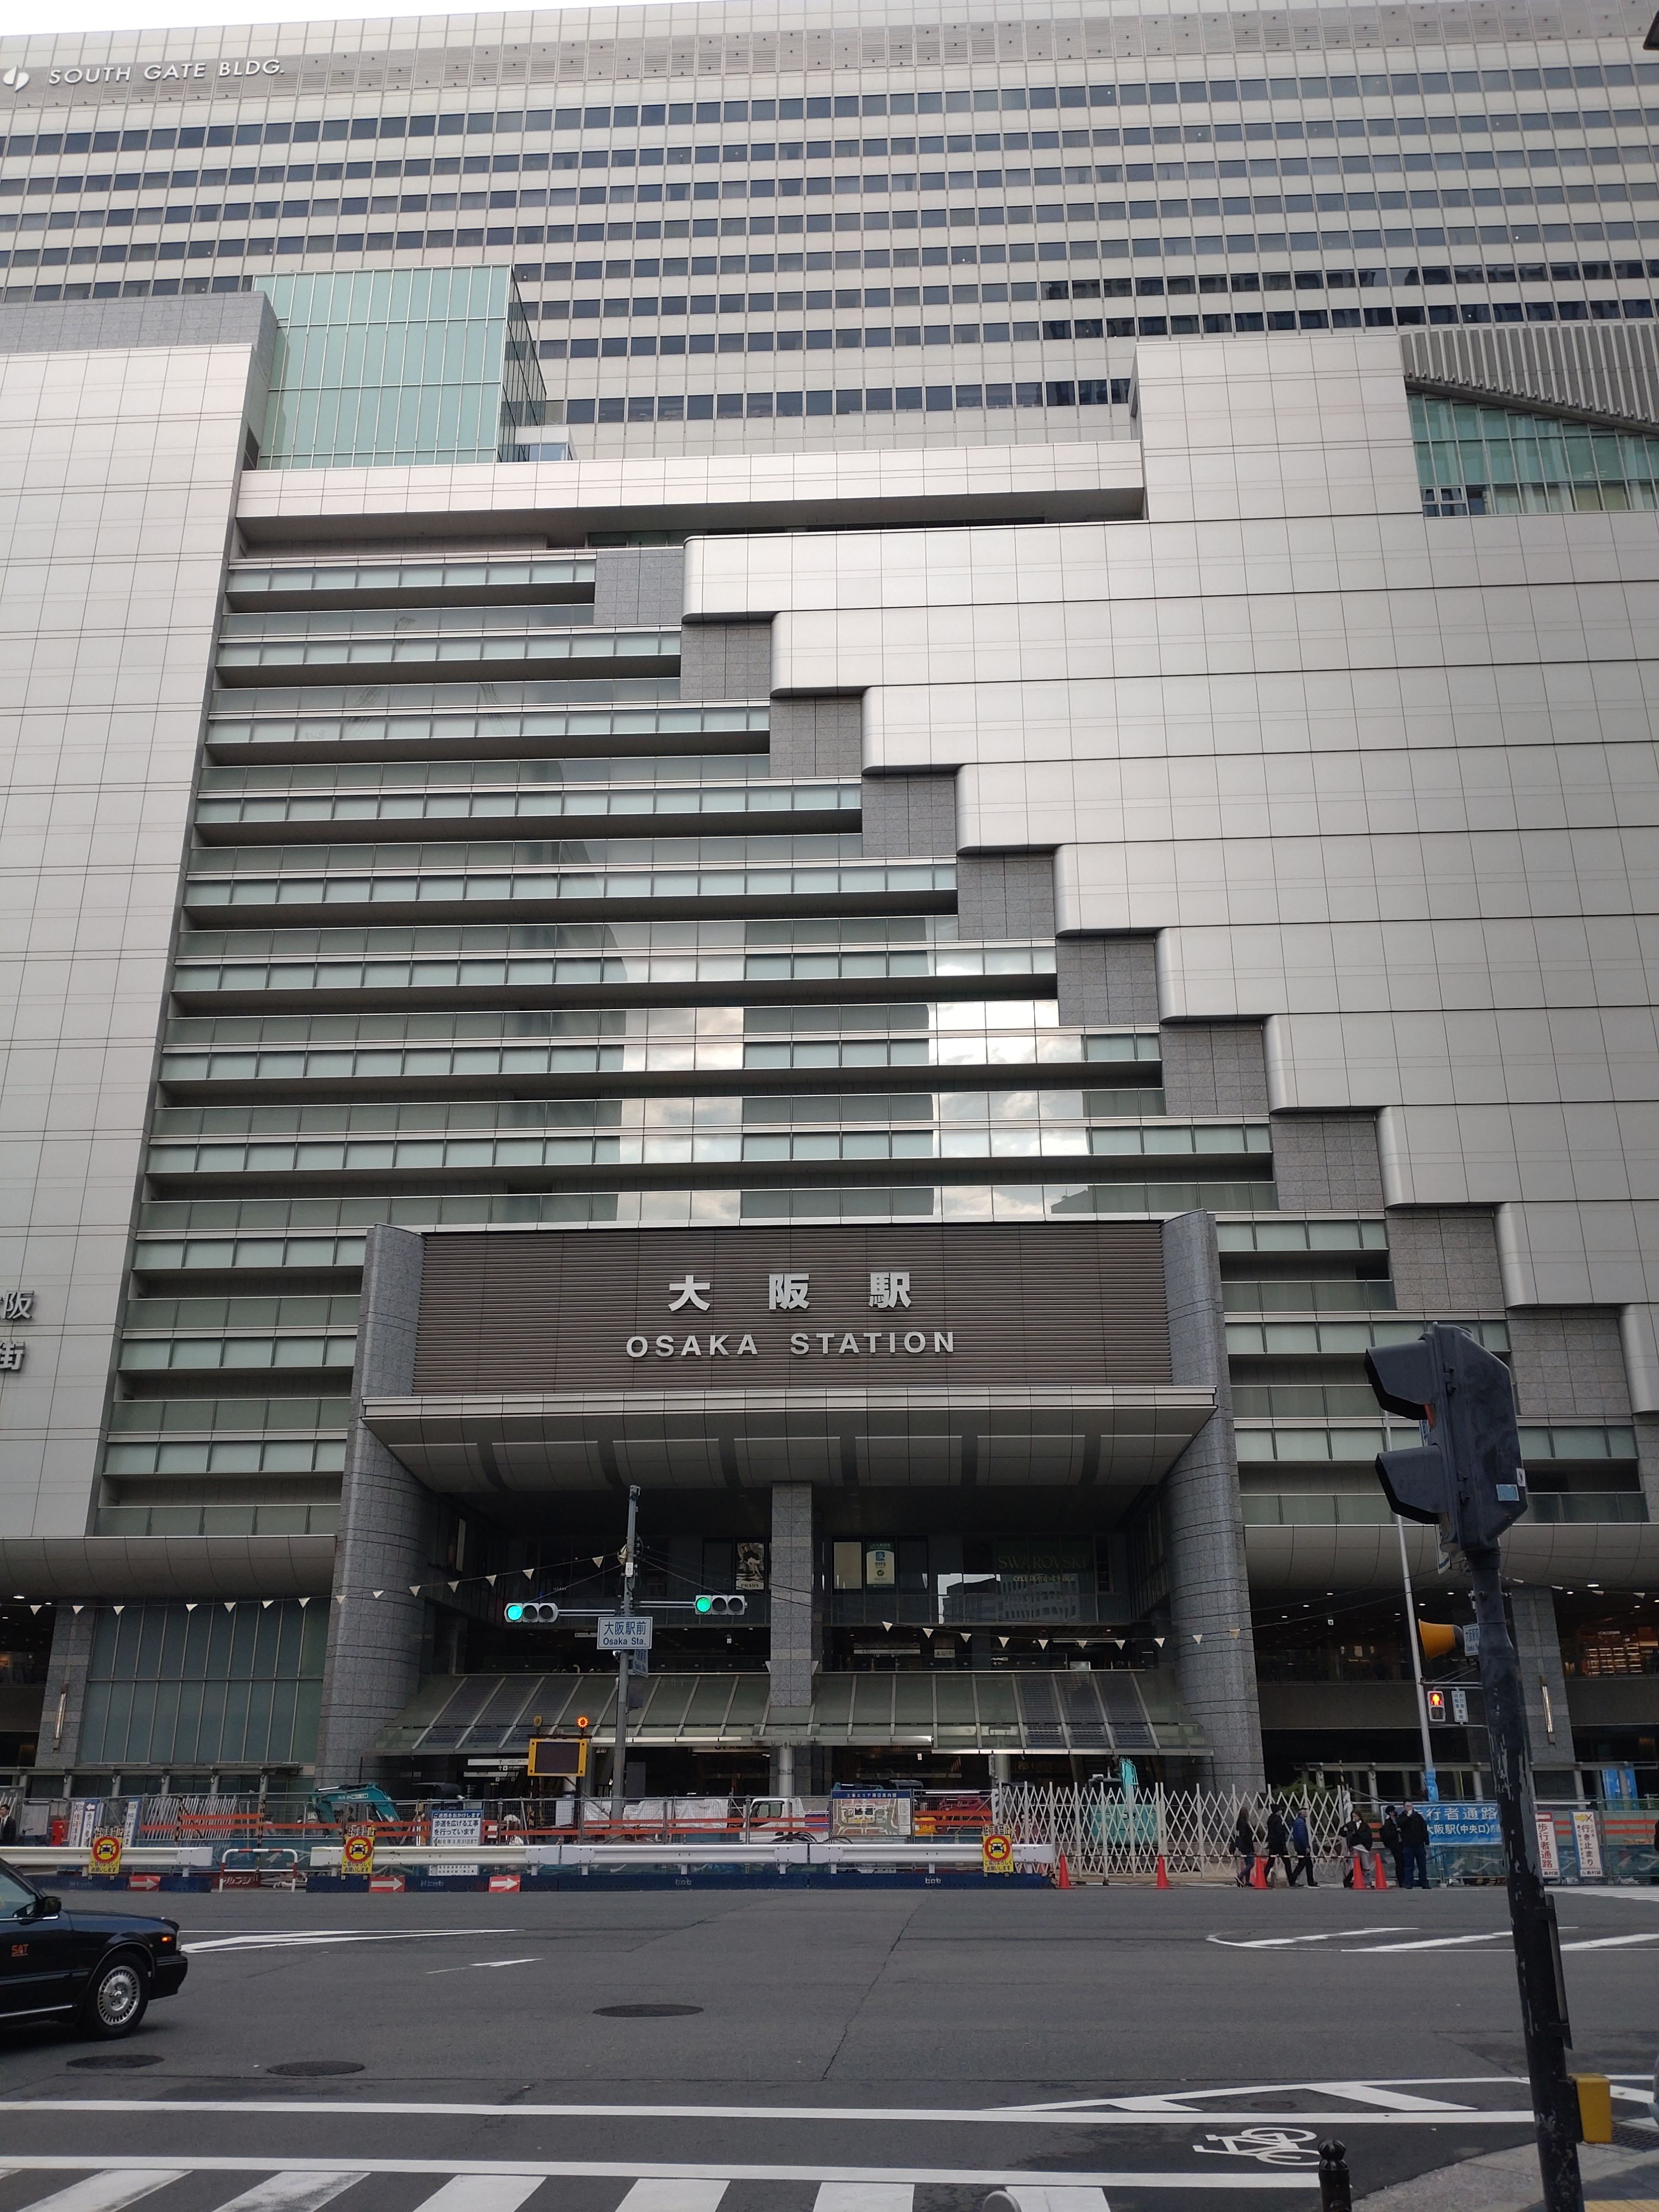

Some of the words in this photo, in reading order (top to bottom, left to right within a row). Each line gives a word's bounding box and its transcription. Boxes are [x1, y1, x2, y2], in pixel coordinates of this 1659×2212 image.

[48, 66, 132, 85] SOUTH
[144, 62, 206, 81] GATE
[218, 59, 285, 77] BLDG.
[0, 1290, 34, 1319] 阪
[668, 1272, 911, 1312] 大阪駅
[626, 1334, 758, 1358] OSAKA
[790, 1331, 954, 1355] STATION
[998, 1556, 1086, 1569] SWAROVSKI
[604, 1620, 646, 1635] 大阪駅前
[632, 1637, 646, 1645] Sta.
[1416, 1807, 1498, 1820] 行者通路
[1538, 1823, 1553, 1868] 歩行者通路
[1581, 1825, 1594, 1866] 行き止まり
[11, 1944, 29, 1955] SAT
